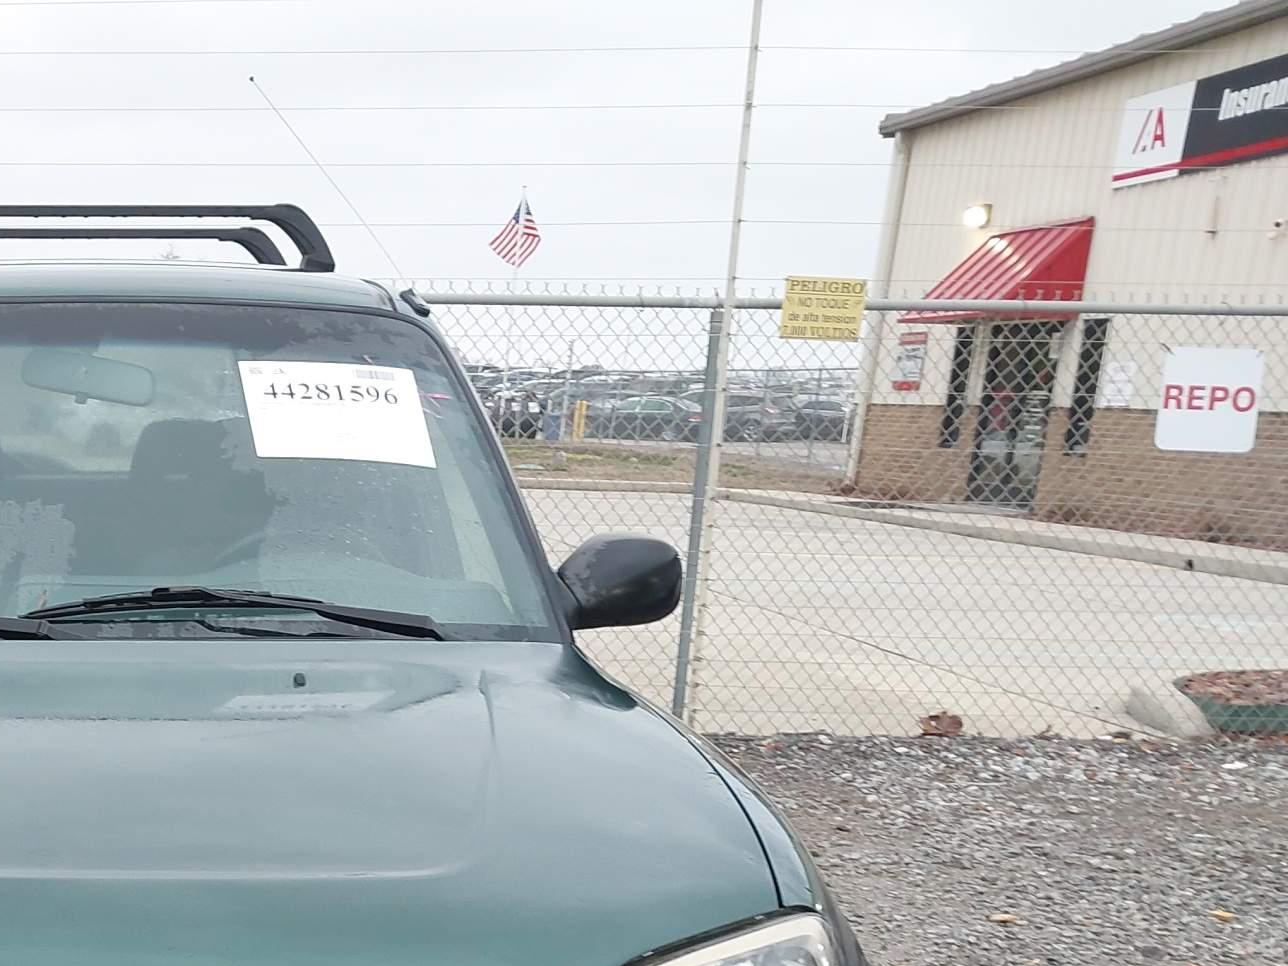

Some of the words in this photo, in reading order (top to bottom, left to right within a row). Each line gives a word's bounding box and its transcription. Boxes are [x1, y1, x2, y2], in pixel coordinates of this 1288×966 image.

[790, 280, 864, 295] PELIGRO
[263, 382, 399, 405] 44281596
[1163, 384, 1257, 413] REPO
